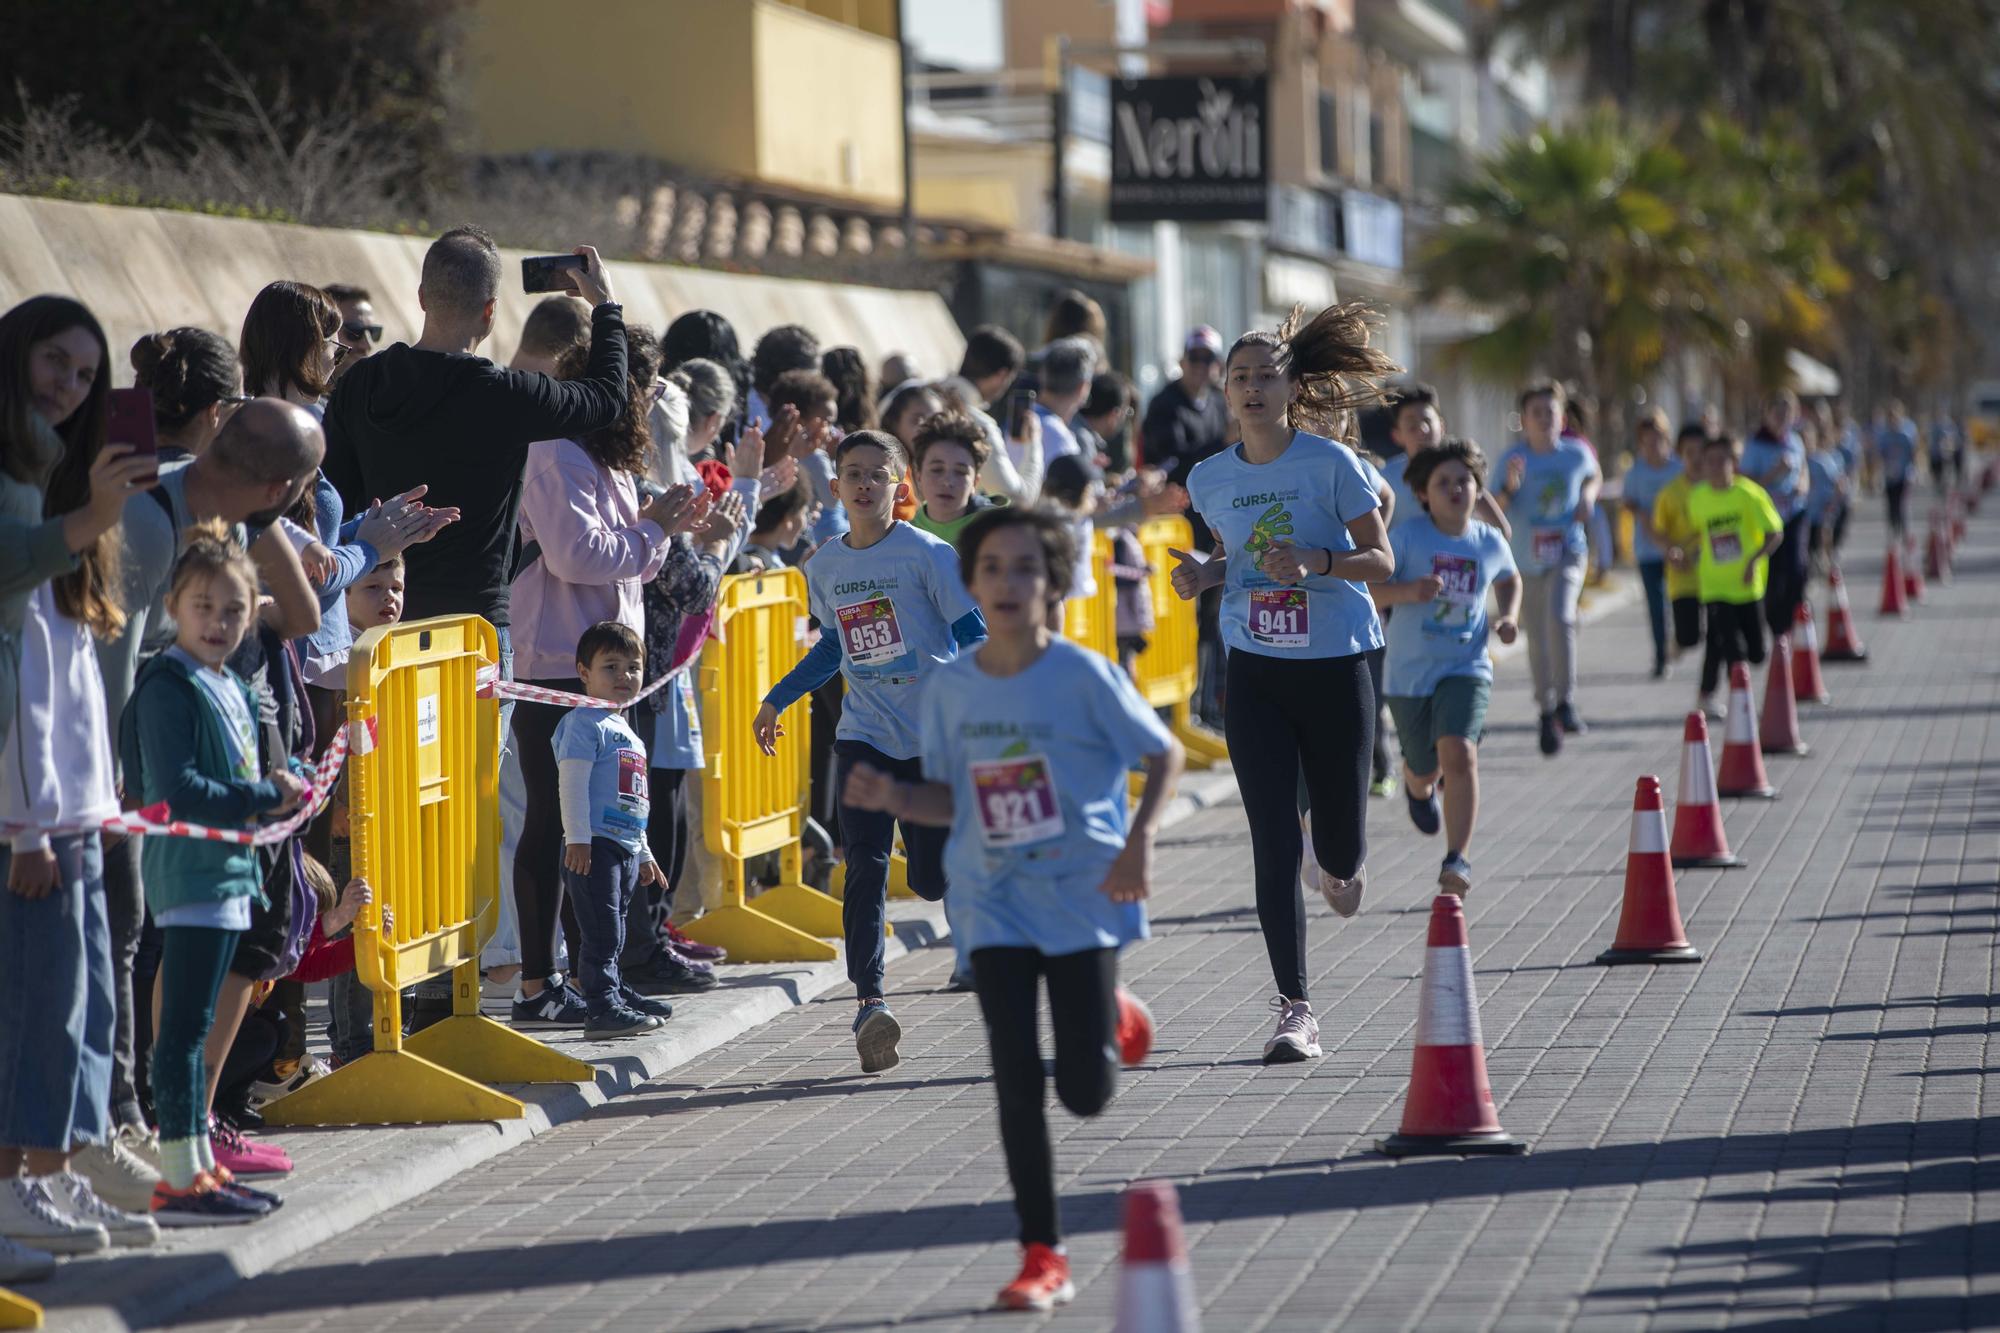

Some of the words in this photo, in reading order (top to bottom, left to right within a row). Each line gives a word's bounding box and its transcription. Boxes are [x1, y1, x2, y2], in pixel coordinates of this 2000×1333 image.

[1116, 100, 1260, 178] Neroli
[1232, 492, 1277, 508] CURSA
[834, 580, 877, 595] CURSA
[839, 606, 861, 616] CURSA
[1258, 610, 1298, 634] 941
[850, 620, 893, 652] 953
[987, 790, 1044, 832] 921
